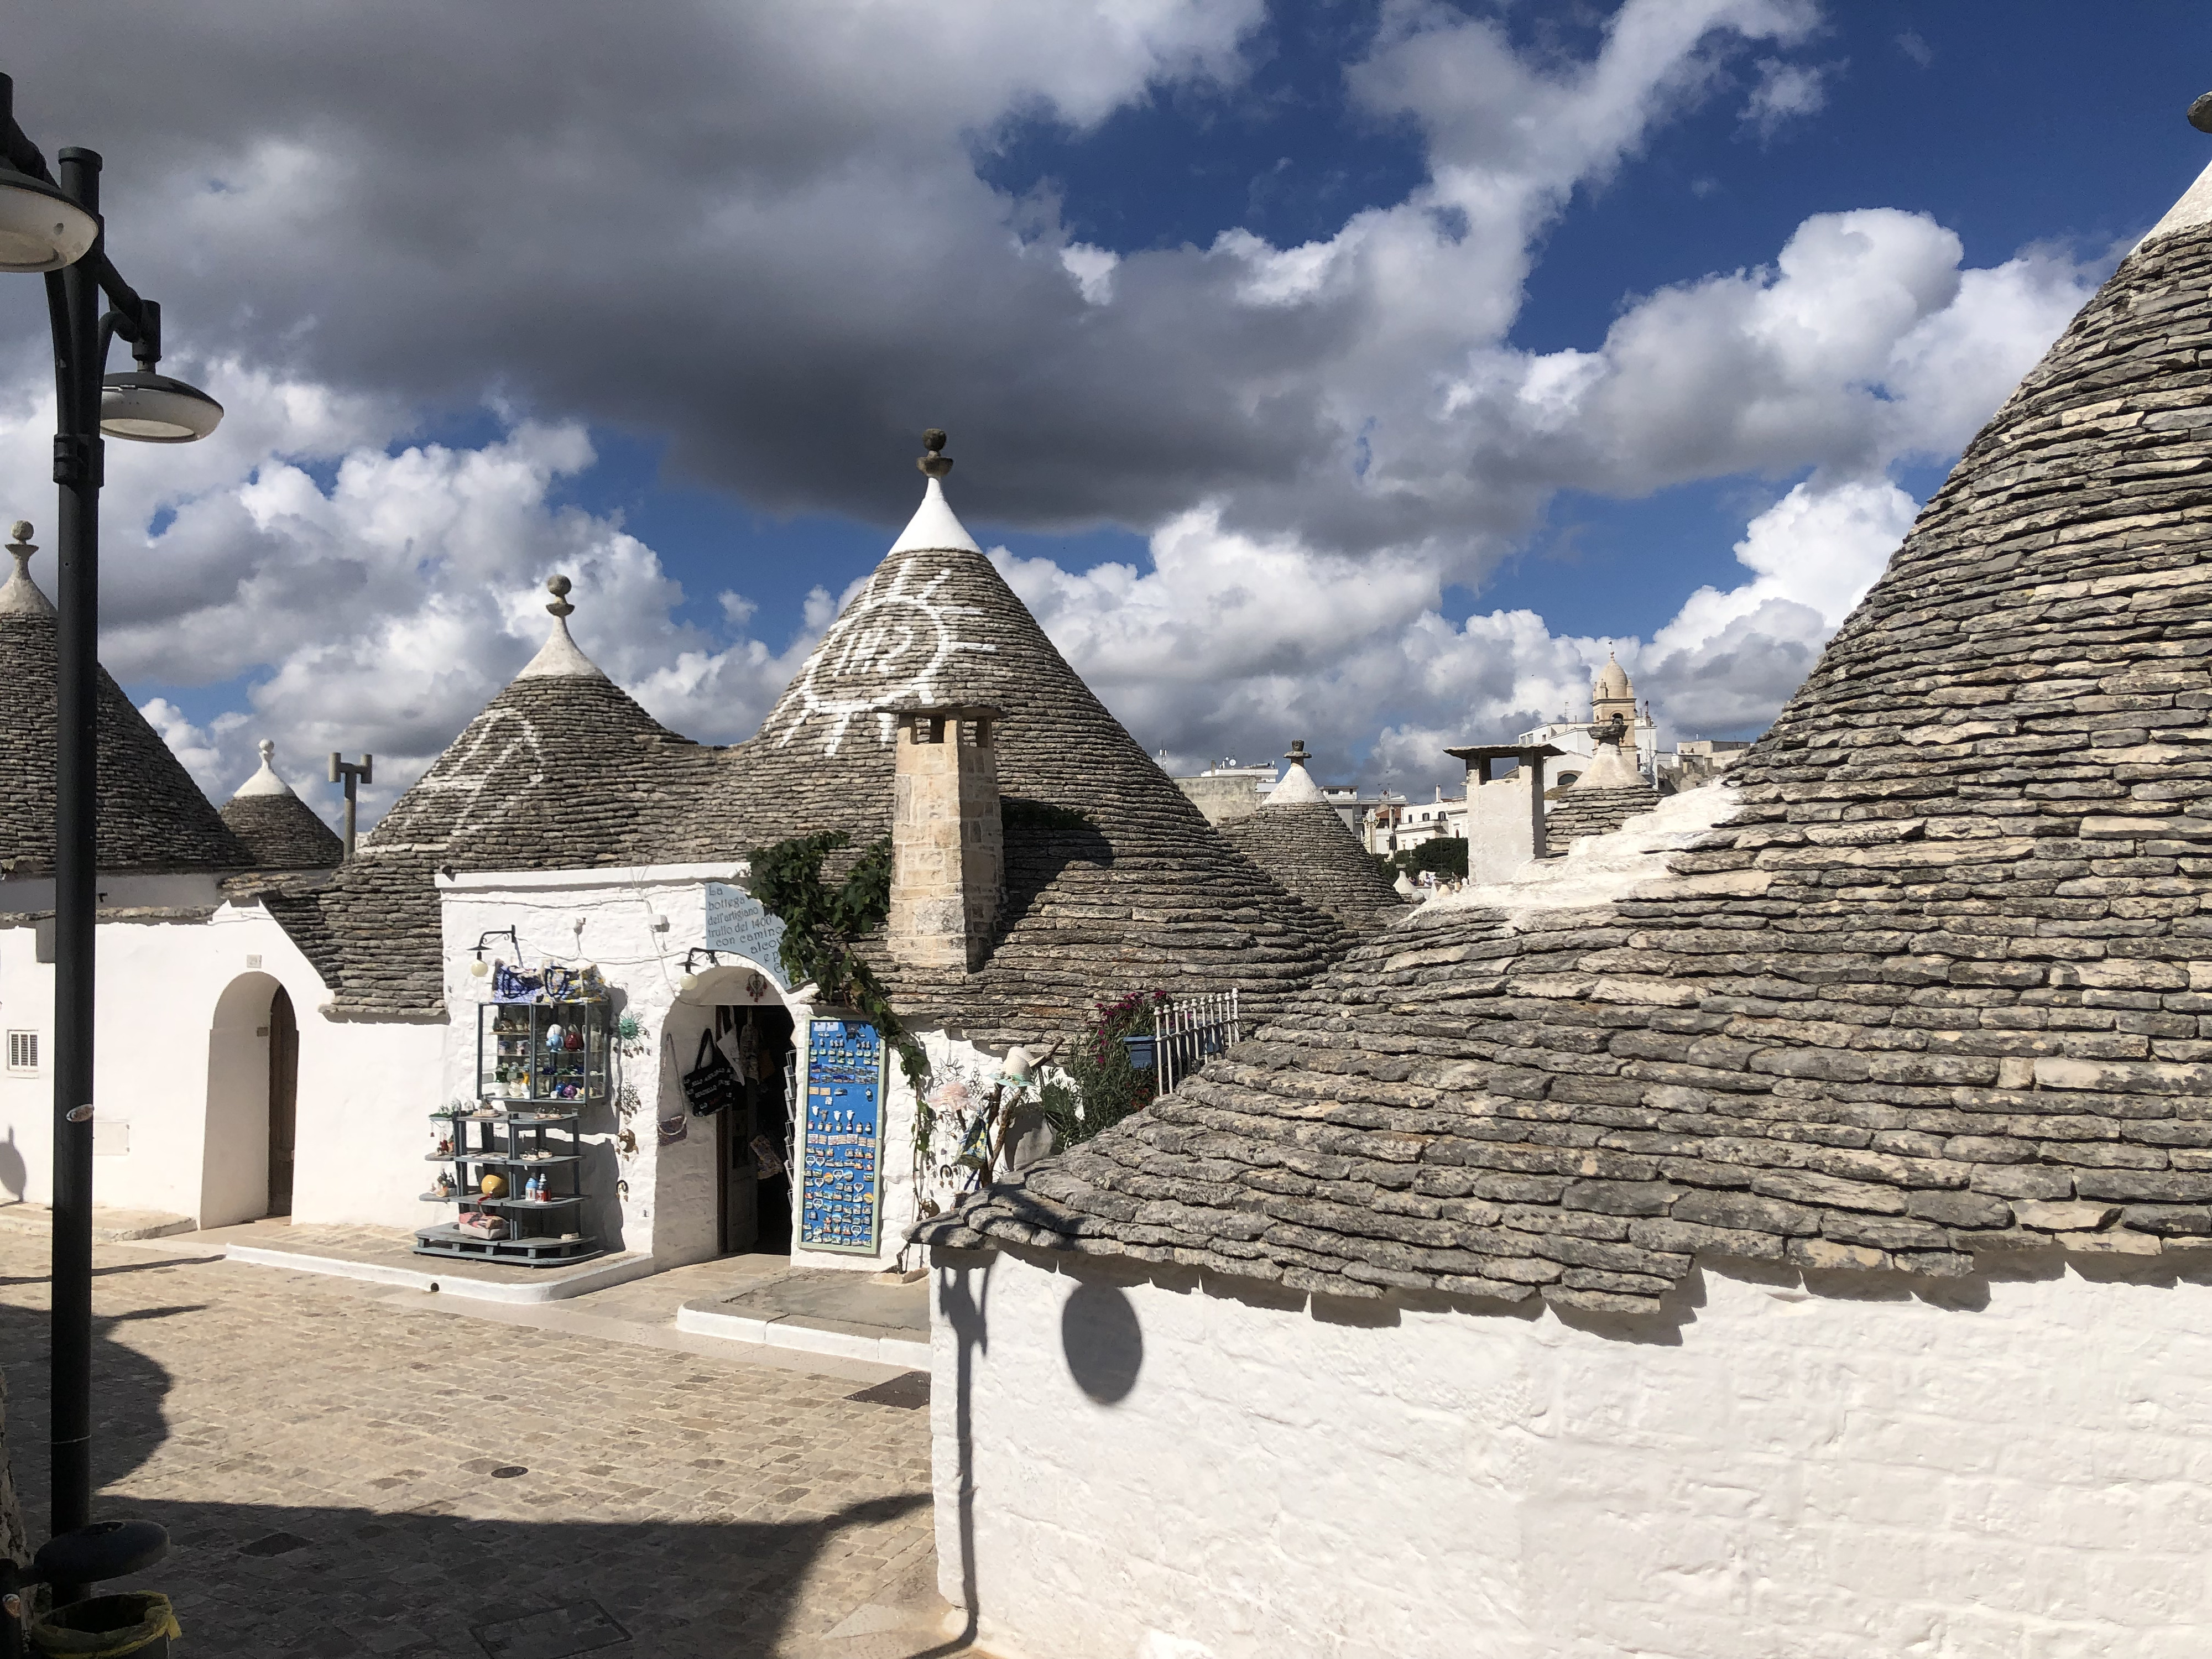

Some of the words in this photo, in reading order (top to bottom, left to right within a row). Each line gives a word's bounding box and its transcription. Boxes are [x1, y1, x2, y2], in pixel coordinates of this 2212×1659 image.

[709, 885, 723, 895] La
[708, 896, 745, 911] bottega
[708, 907, 758, 925] dell'artigiano
[708, 925, 732, 937] trullo
[734, 921, 748, 933] del
[751, 916, 771, 929] 1400
[716, 937, 735, 947] con
[740, 926, 783, 943] camino
[750, 936, 782, 954] alcov
